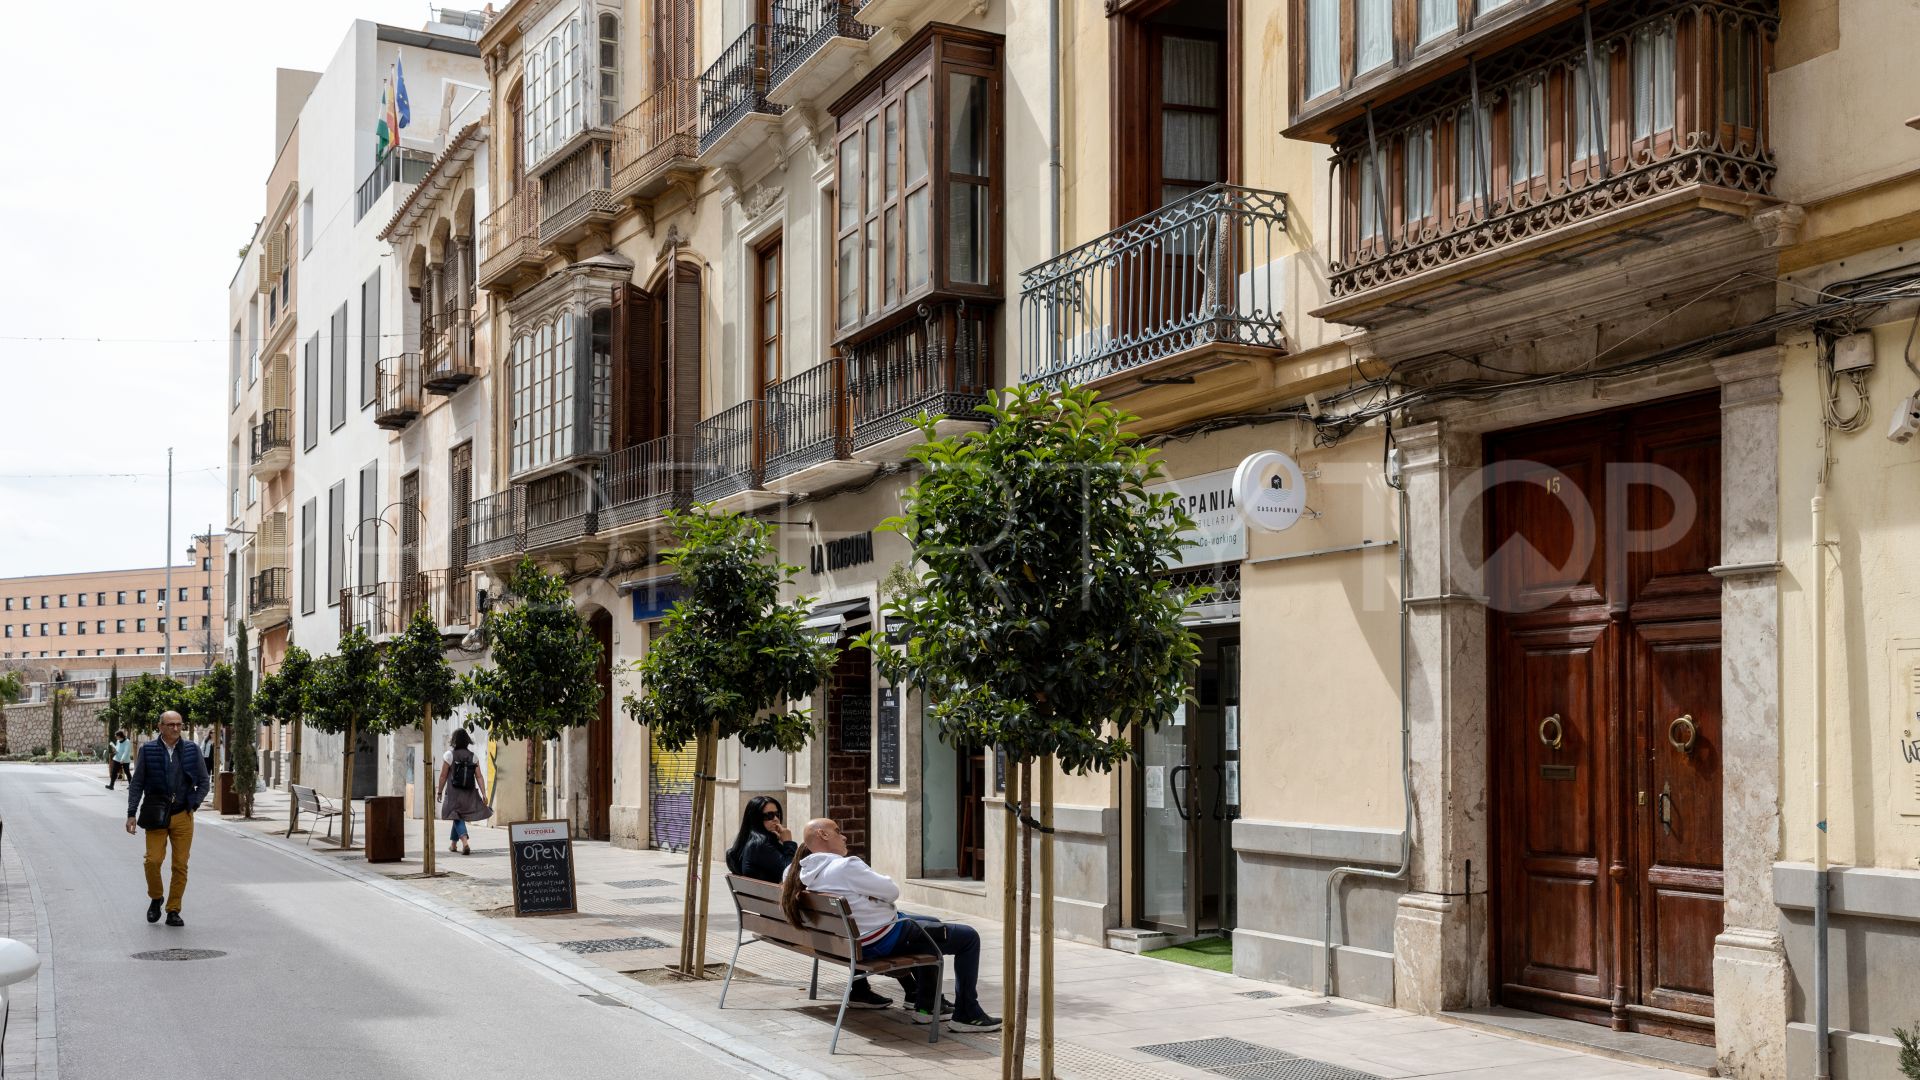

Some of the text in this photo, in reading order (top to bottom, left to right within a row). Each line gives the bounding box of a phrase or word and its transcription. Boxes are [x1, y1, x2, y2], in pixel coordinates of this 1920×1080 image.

[1546, 476, 1561, 495] 15
[1257, 506, 1298, 514] CASASPANIA
[1199, 533, 1237, 548] Co-working
[810, 530, 874, 575] LA TRIBUNA
